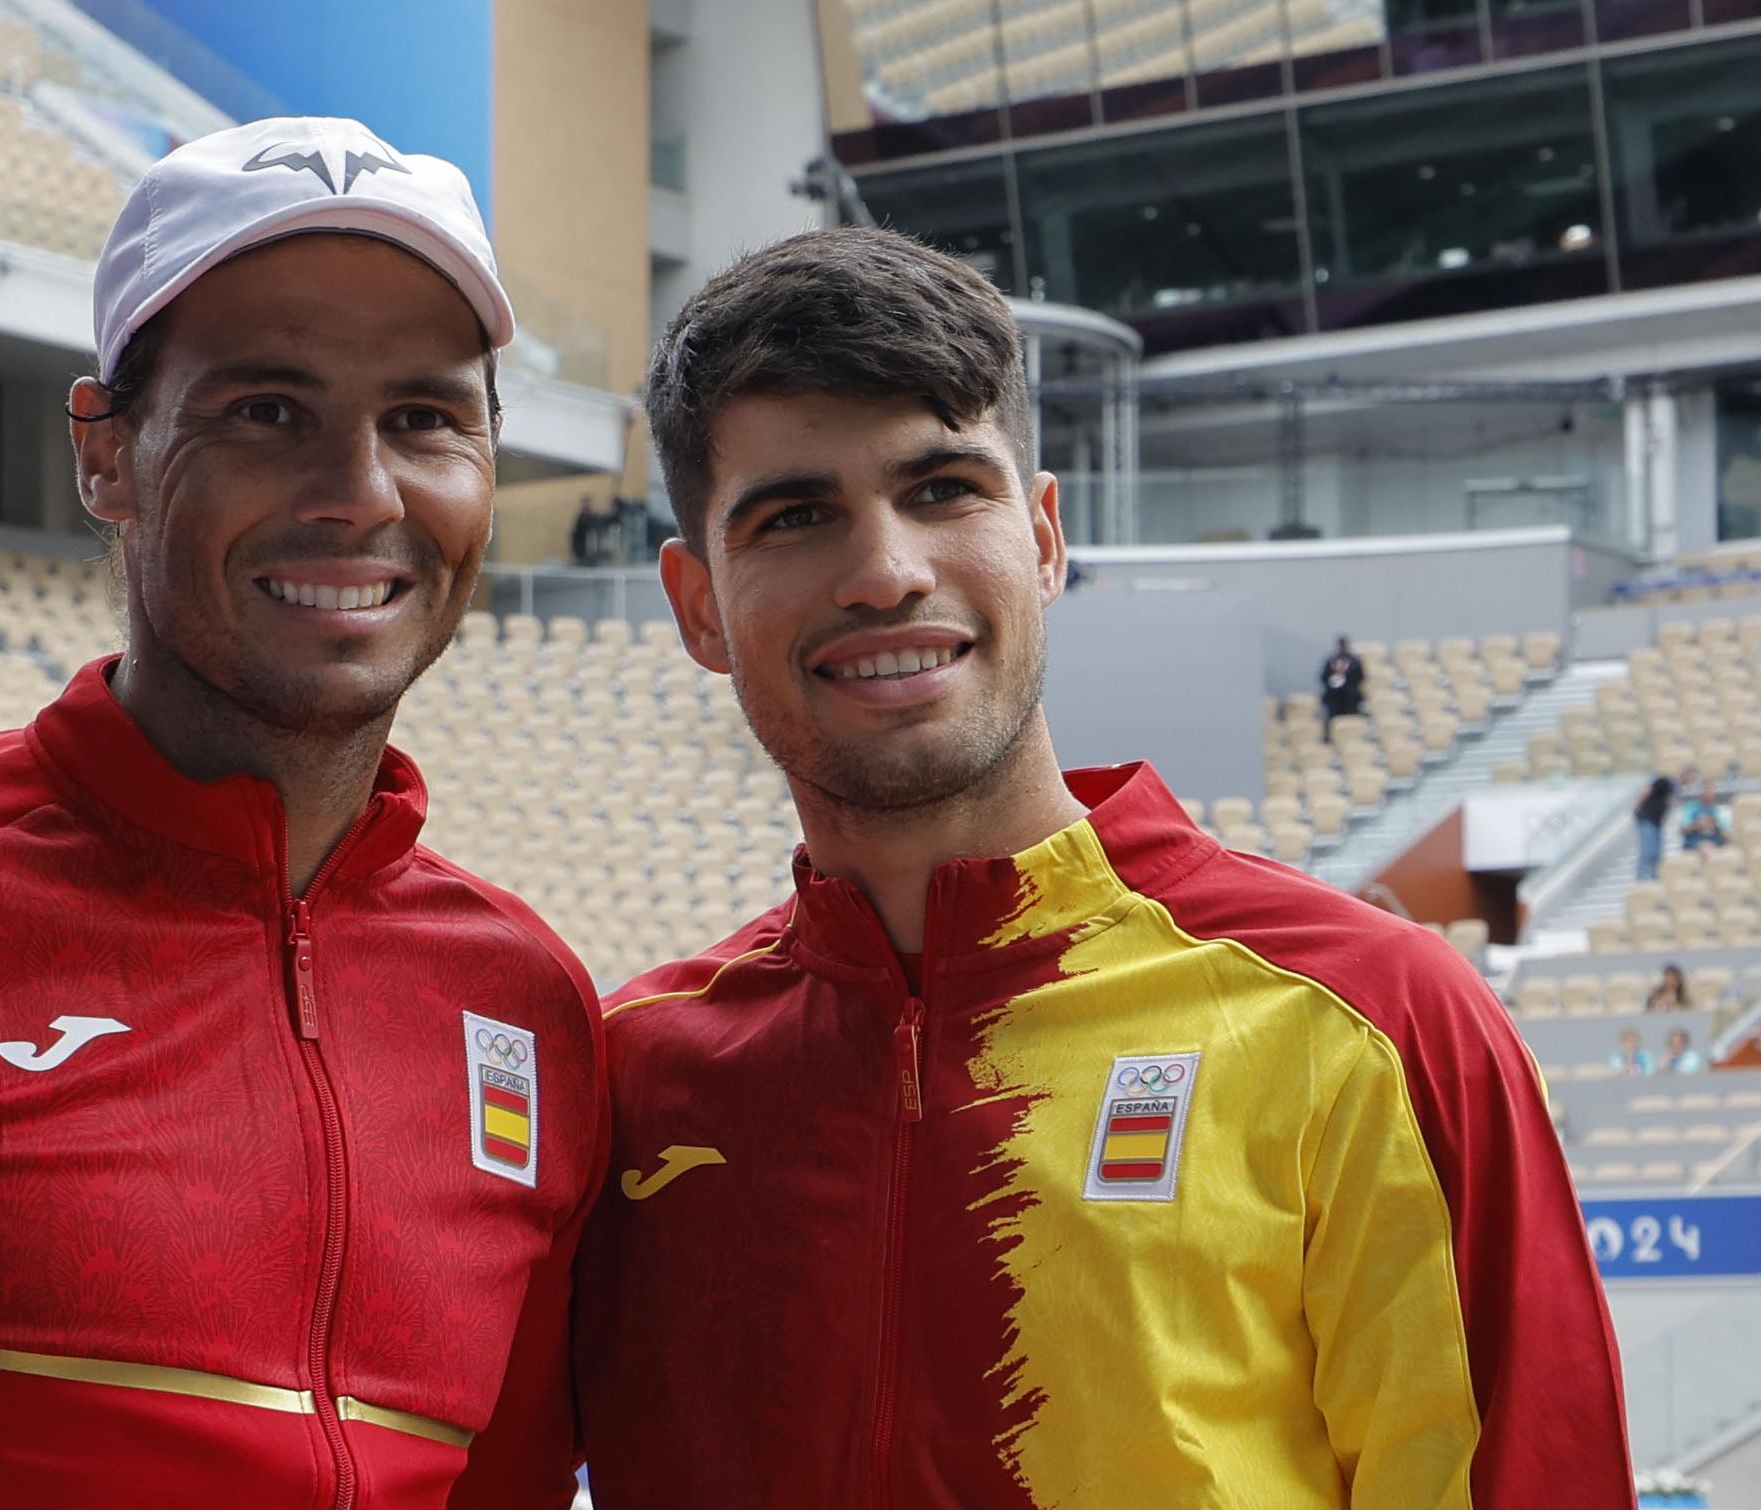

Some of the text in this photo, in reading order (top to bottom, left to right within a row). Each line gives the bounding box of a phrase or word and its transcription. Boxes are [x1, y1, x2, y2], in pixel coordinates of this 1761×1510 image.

[485, 1070, 527, 1092] ESPAÑA
[902, 1070, 918, 1110] ESP
[1116, 1100, 1169, 1113] ESPAÑA
[1587, 1215, 1701, 1263] 024
